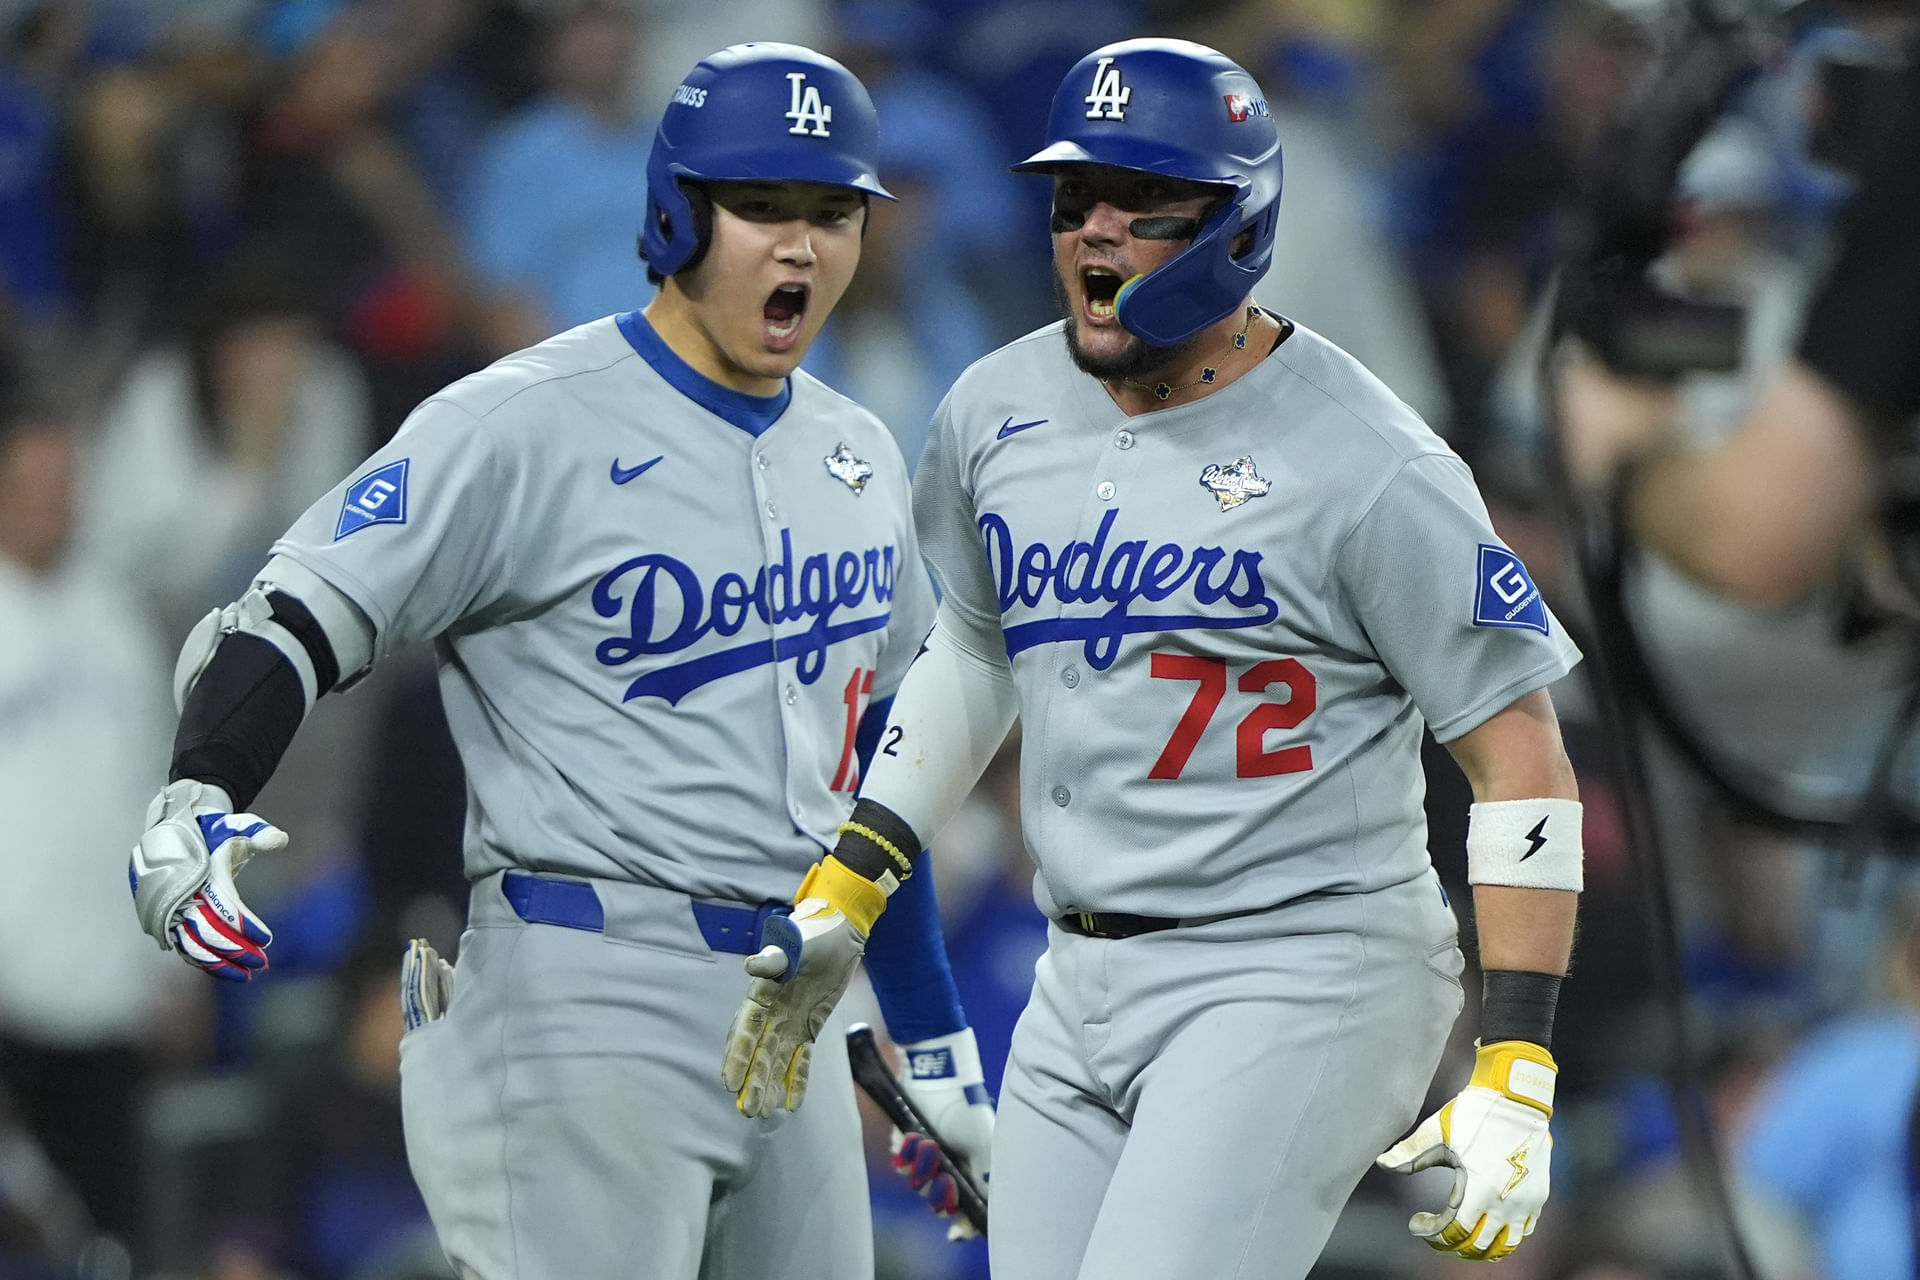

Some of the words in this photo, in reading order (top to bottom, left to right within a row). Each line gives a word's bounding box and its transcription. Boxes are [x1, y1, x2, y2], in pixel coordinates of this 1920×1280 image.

[785, 72, 832, 138] LA
[1085, 57, 1131, 122] LA
[359, 478, 397, 510] G
[1490, 561, 1528, 605] G
[1147, 652, 1316, 780] 72
[205, 882, 235, 922] balance
